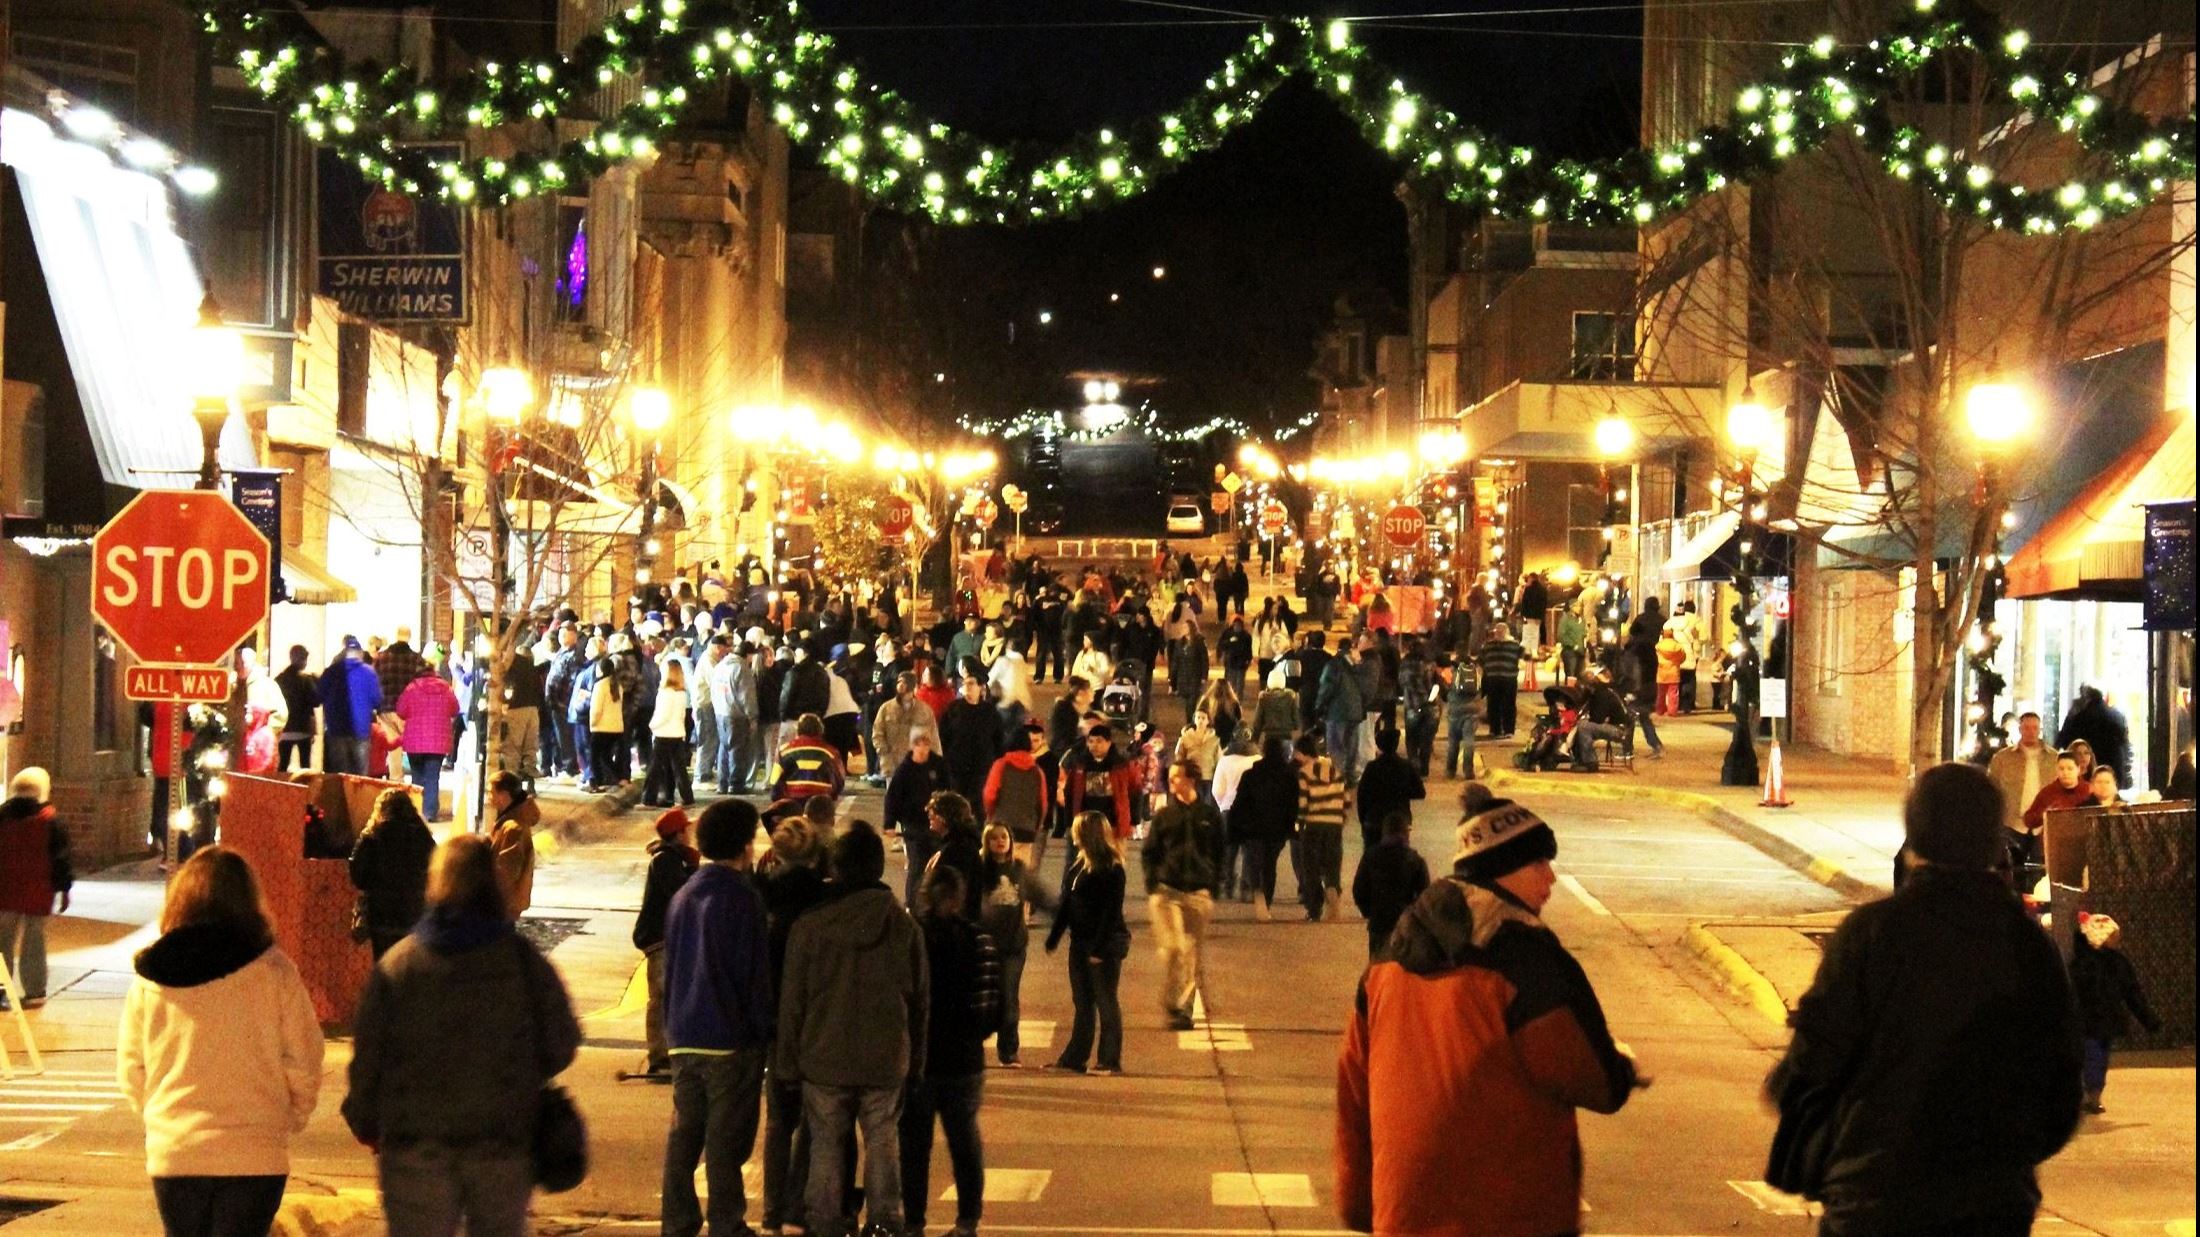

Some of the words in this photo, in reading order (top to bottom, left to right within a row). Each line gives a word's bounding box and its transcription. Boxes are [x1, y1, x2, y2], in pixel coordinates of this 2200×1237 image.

[333, 263, 451, 286] SHERWIN
[1385, 518, 1423, 534] STOP
[103, 545, 259, 610] STOP
[134, 673, 169, 693] ALL
[182, 674, 221, 695] WAY
